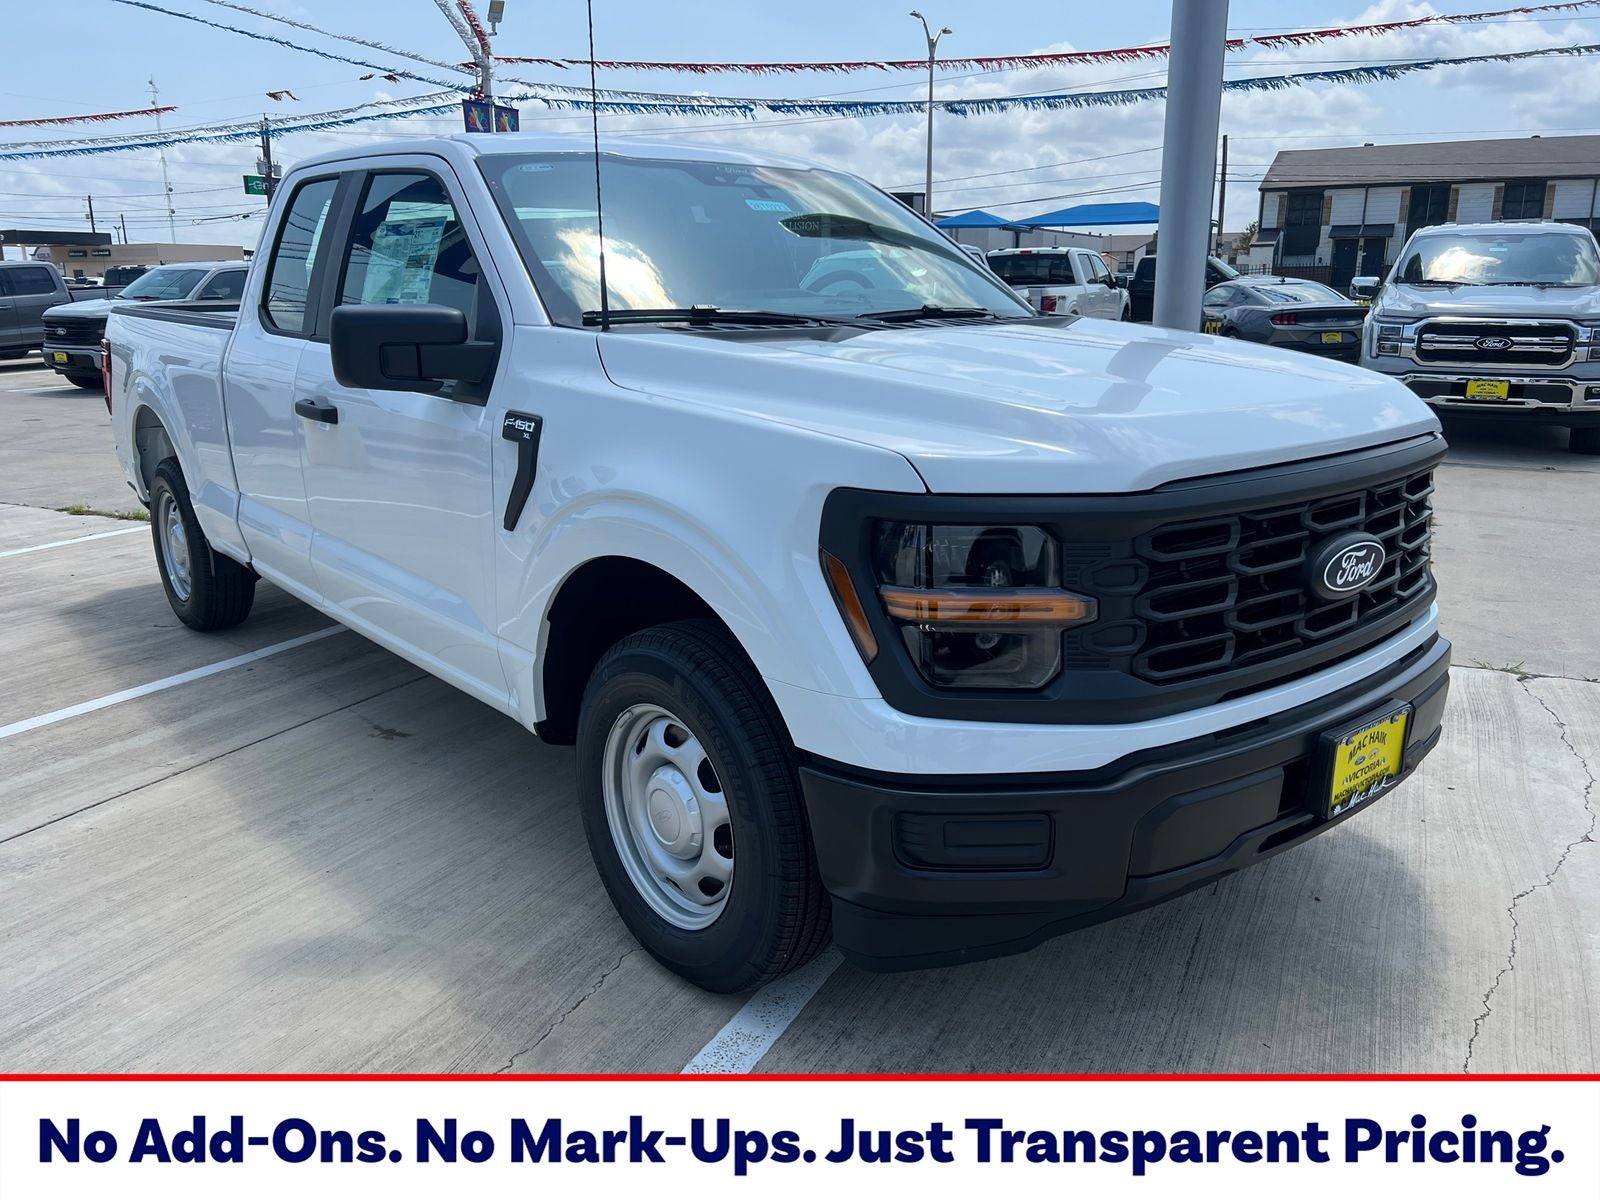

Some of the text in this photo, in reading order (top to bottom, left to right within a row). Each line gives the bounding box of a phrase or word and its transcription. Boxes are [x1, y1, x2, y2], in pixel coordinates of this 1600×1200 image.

[1482, 338, 1505, 347] Ford
[504, 418, 536, 432] F-150
[523, 432, 531, 440] XL
[1336, 548, 1376, 586] Ford
[1347, 735, 1369, 764] MAC
[1368, 730, 1388, 746] HAIK
